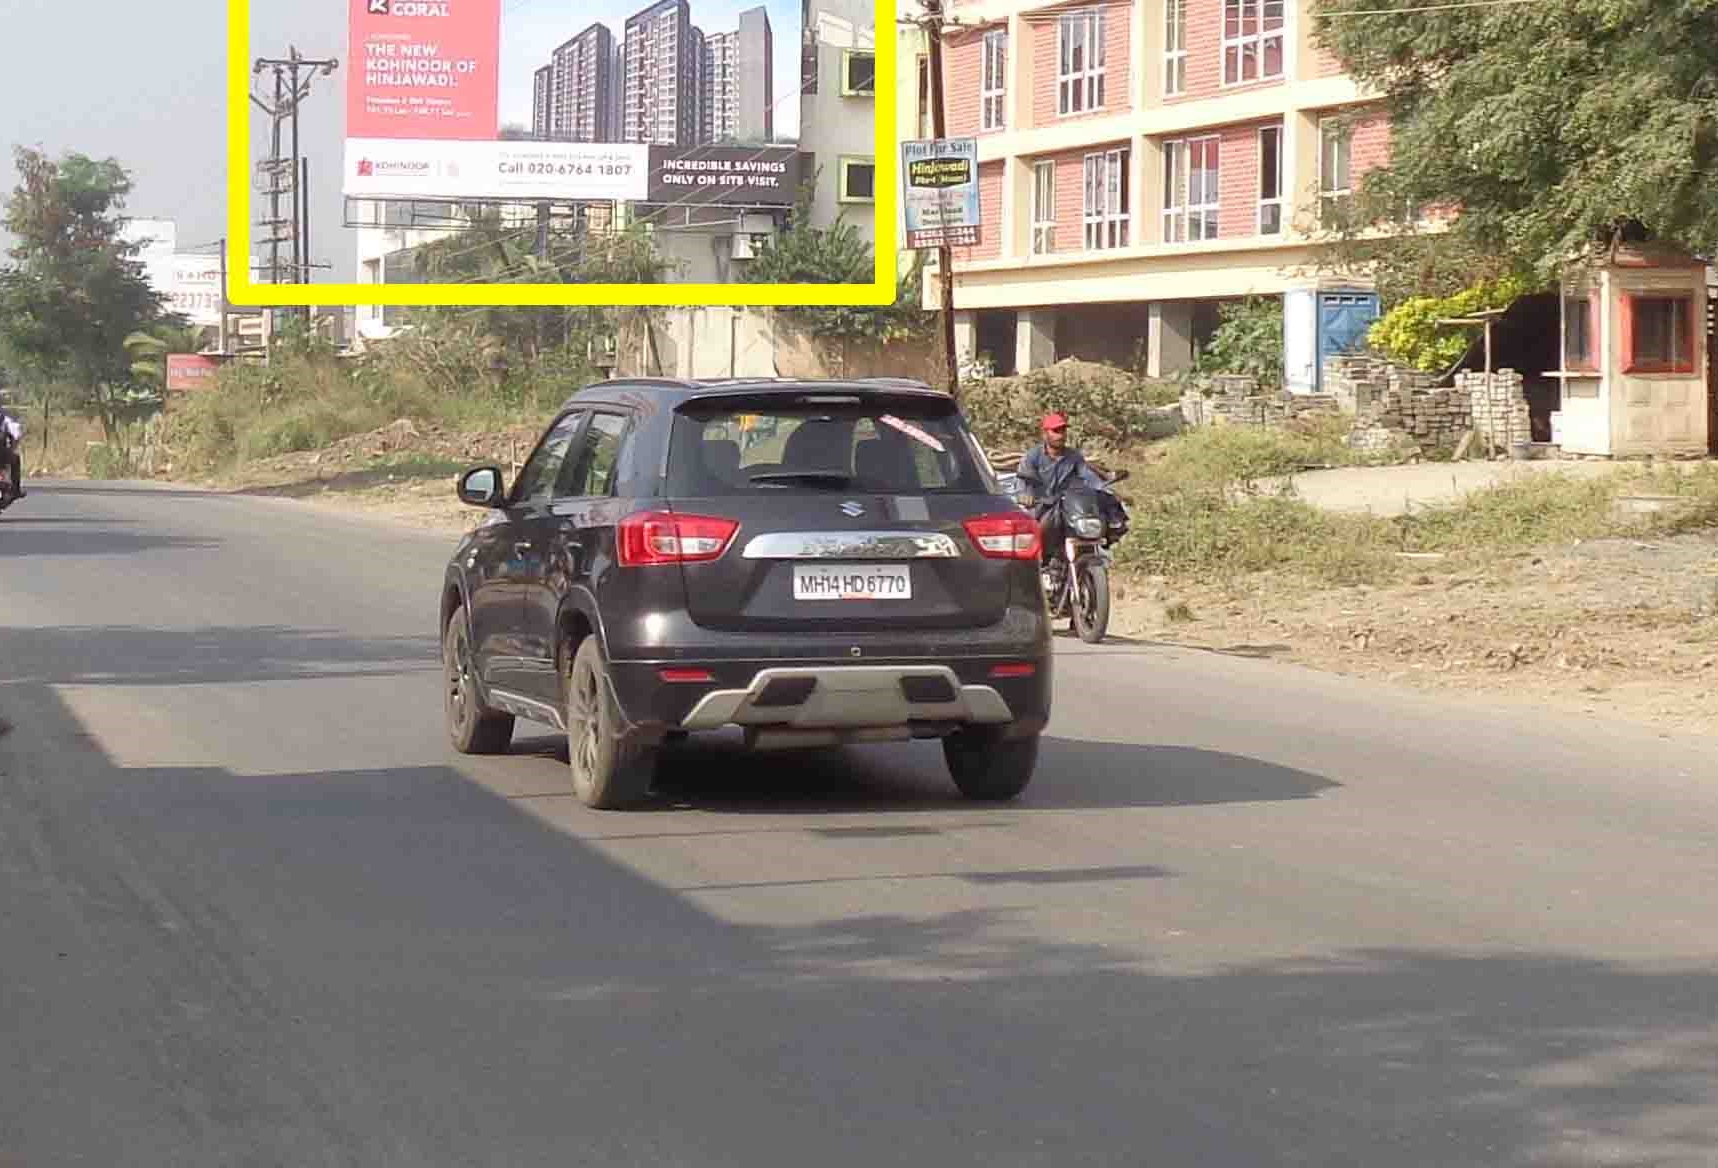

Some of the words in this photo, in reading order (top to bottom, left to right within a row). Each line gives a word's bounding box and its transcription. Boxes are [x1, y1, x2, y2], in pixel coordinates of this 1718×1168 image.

[393, 3, 450, 16] CORAL
[365, 43, 396, 57] THE
[401, 44, 437, 57] NEW
[366, 59, 451, 72] KOHINOOR
[456, 61, 476, 73] OF
[498, 162, 524, 174] Call
[662, 159, 732, 171] INCREDIBLE
[735, 160, 786, 173] SAVINGS
[663, 174, 695, 185] ONLY
[697, 175, 717, 185] ON
[719, 175, 744, 186] SITE
[800, 575, 840, 594] MH14
[843, 575, 865, 593] HD
[867, 575, 905, 593] 6770
